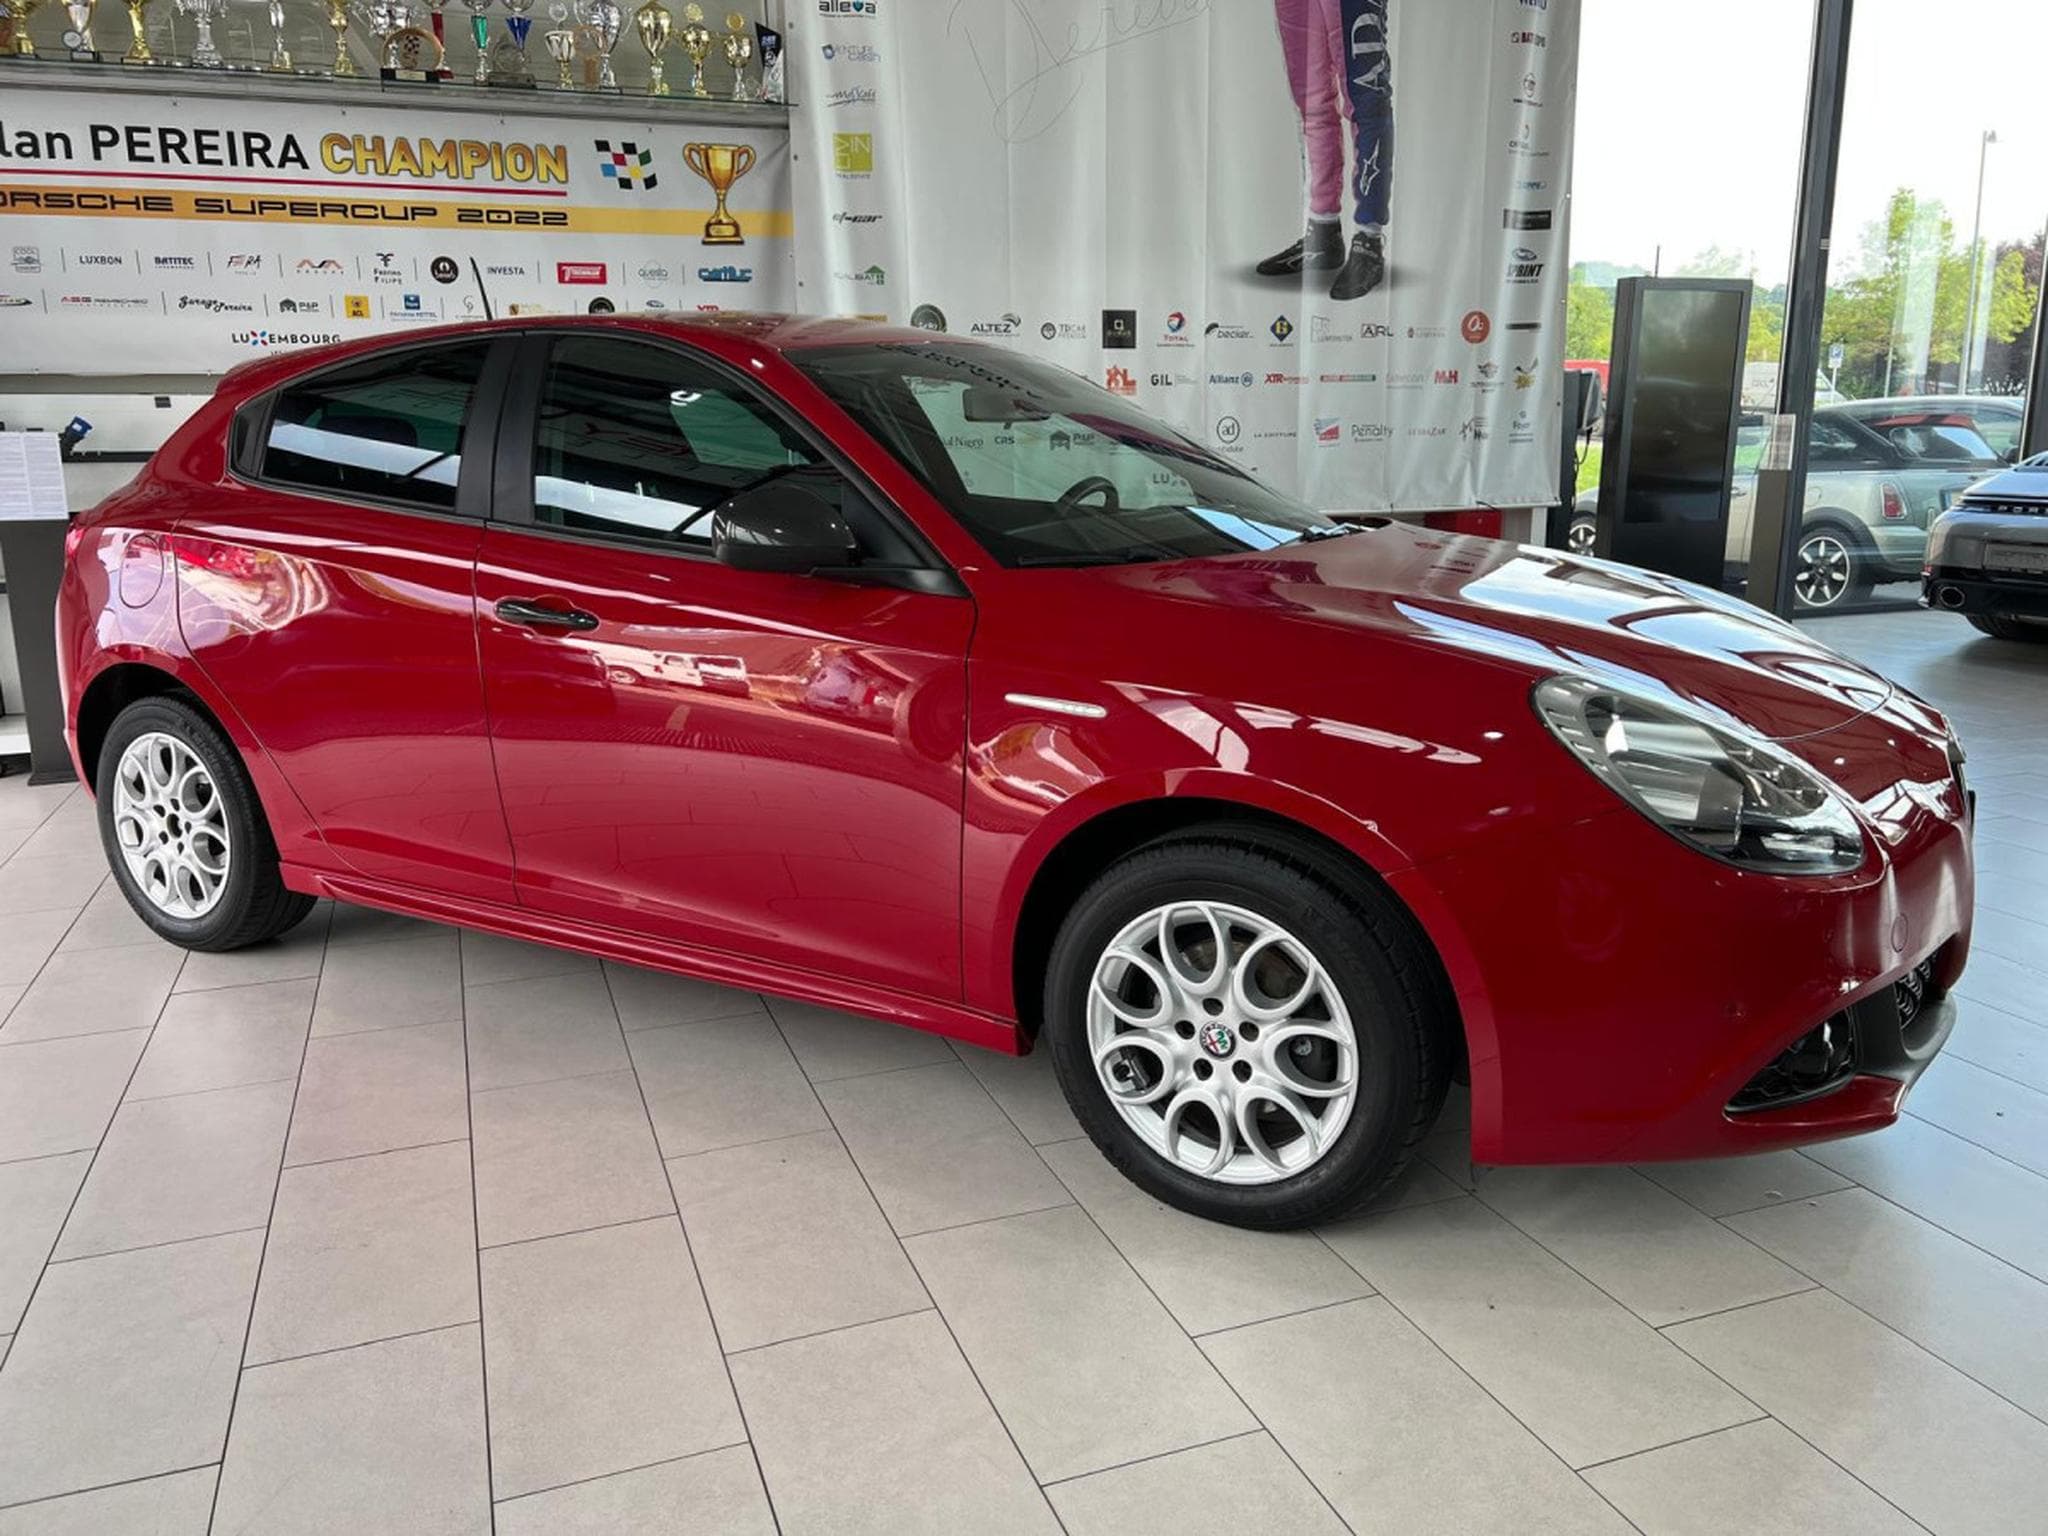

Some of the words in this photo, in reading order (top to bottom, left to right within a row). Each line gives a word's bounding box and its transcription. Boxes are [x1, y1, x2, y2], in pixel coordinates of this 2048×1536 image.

[88, 124, 310, 170] PEREIRA
[319, 132, 569, 184] CHAMPION
[194, 198, 437, 222] SUPERCUP
[456, 208, 569, 226] 2022
[78, 255, 123, 265] LUXBON
[154, 256, 195, 266] BATITEC
[487, 266, 525, 276] INVESTA
[178, 295, 218, 311] Garage
[970, 323, 1012, 334] ALTEZ
[1217, 329, 1250, 339] becker
[1361, 323, 1395, 338] ARL
[231, 330, 341, 346] LUXEMBOURG
[1150, 373, 1173, 387] GIL
[1209, 373, 1240, 385] Allianz
[1351, 423, 1394, 438] Penalty
